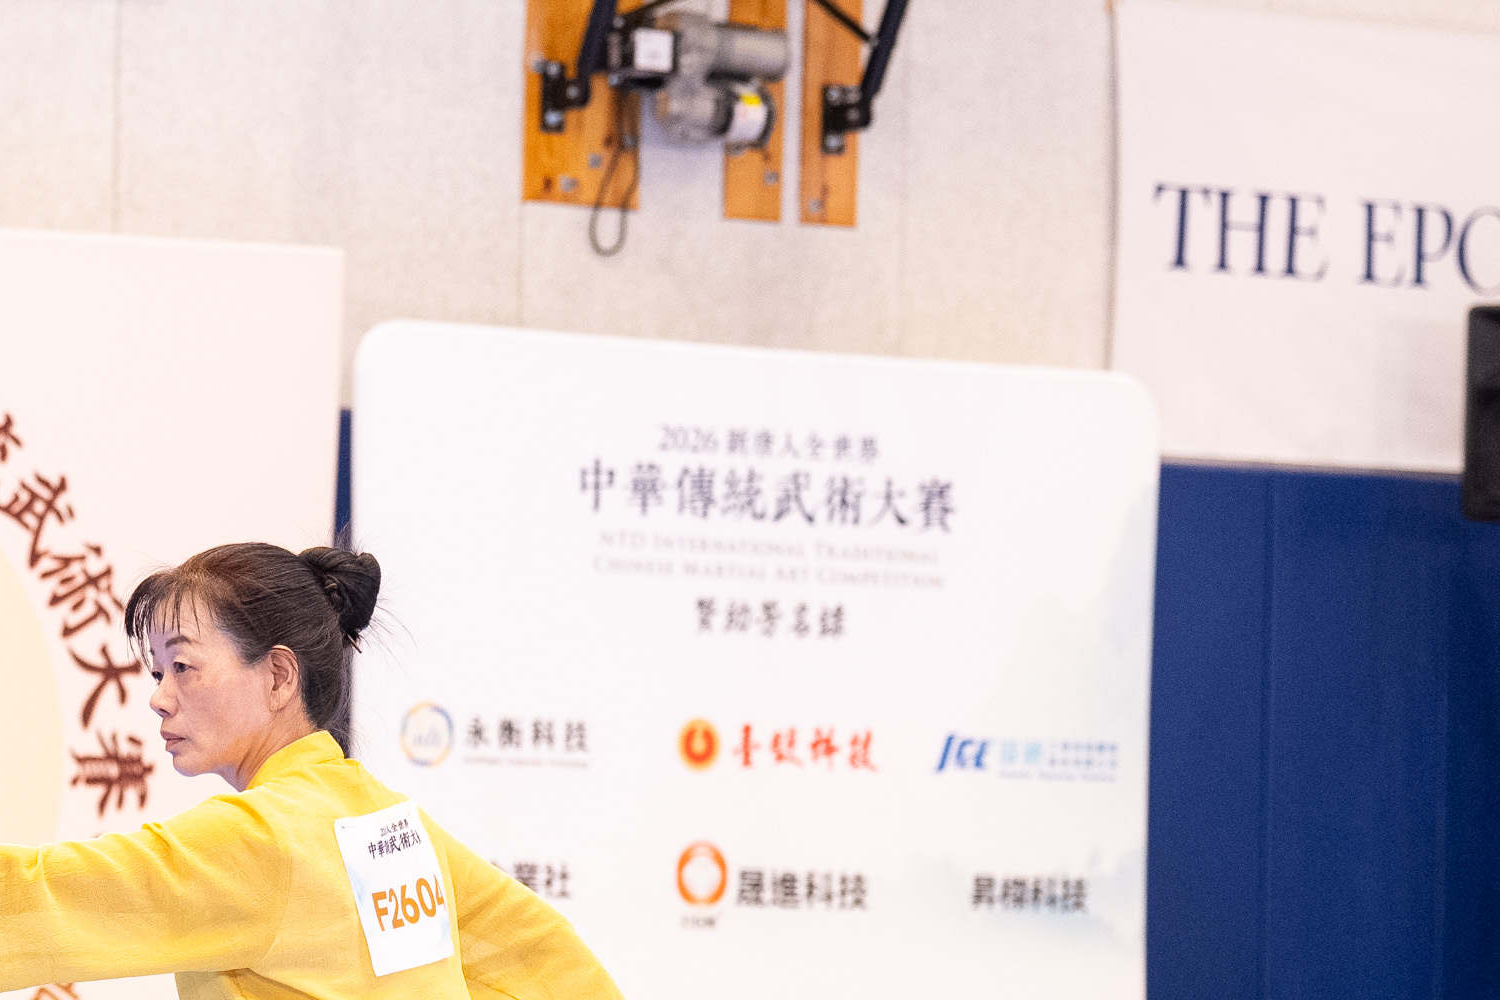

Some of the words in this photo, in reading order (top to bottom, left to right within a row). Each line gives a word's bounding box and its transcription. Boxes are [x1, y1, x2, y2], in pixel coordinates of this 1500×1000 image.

[1153, 181, 1329, 282] THE
[660, 424, 719, 455] 2026
[580, 456, 955, 533] 中華傳統武術大賽
[372, 874, 446, 931] F2604
